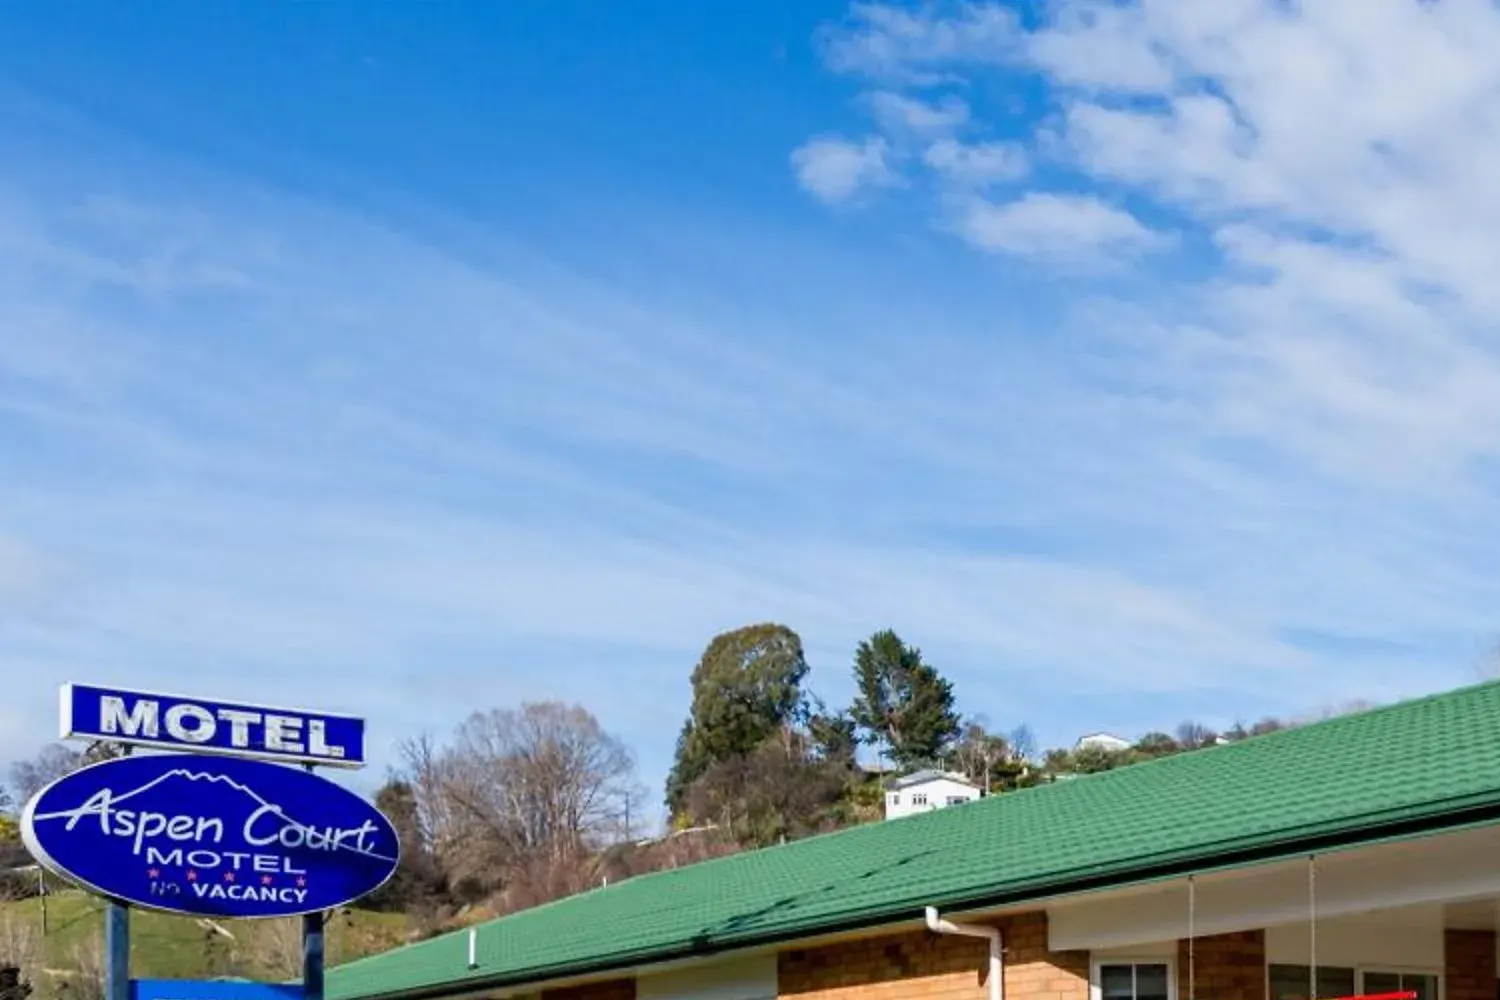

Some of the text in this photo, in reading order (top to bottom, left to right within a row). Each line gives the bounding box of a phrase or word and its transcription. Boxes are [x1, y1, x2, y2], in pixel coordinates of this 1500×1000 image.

[100, 695, 345, 757] MOTEL
[65, 788, 379, 855] Aspen Court
[146, 847, 306, 875] MOTEL
[192, 883, 308, 903] VACANCY
